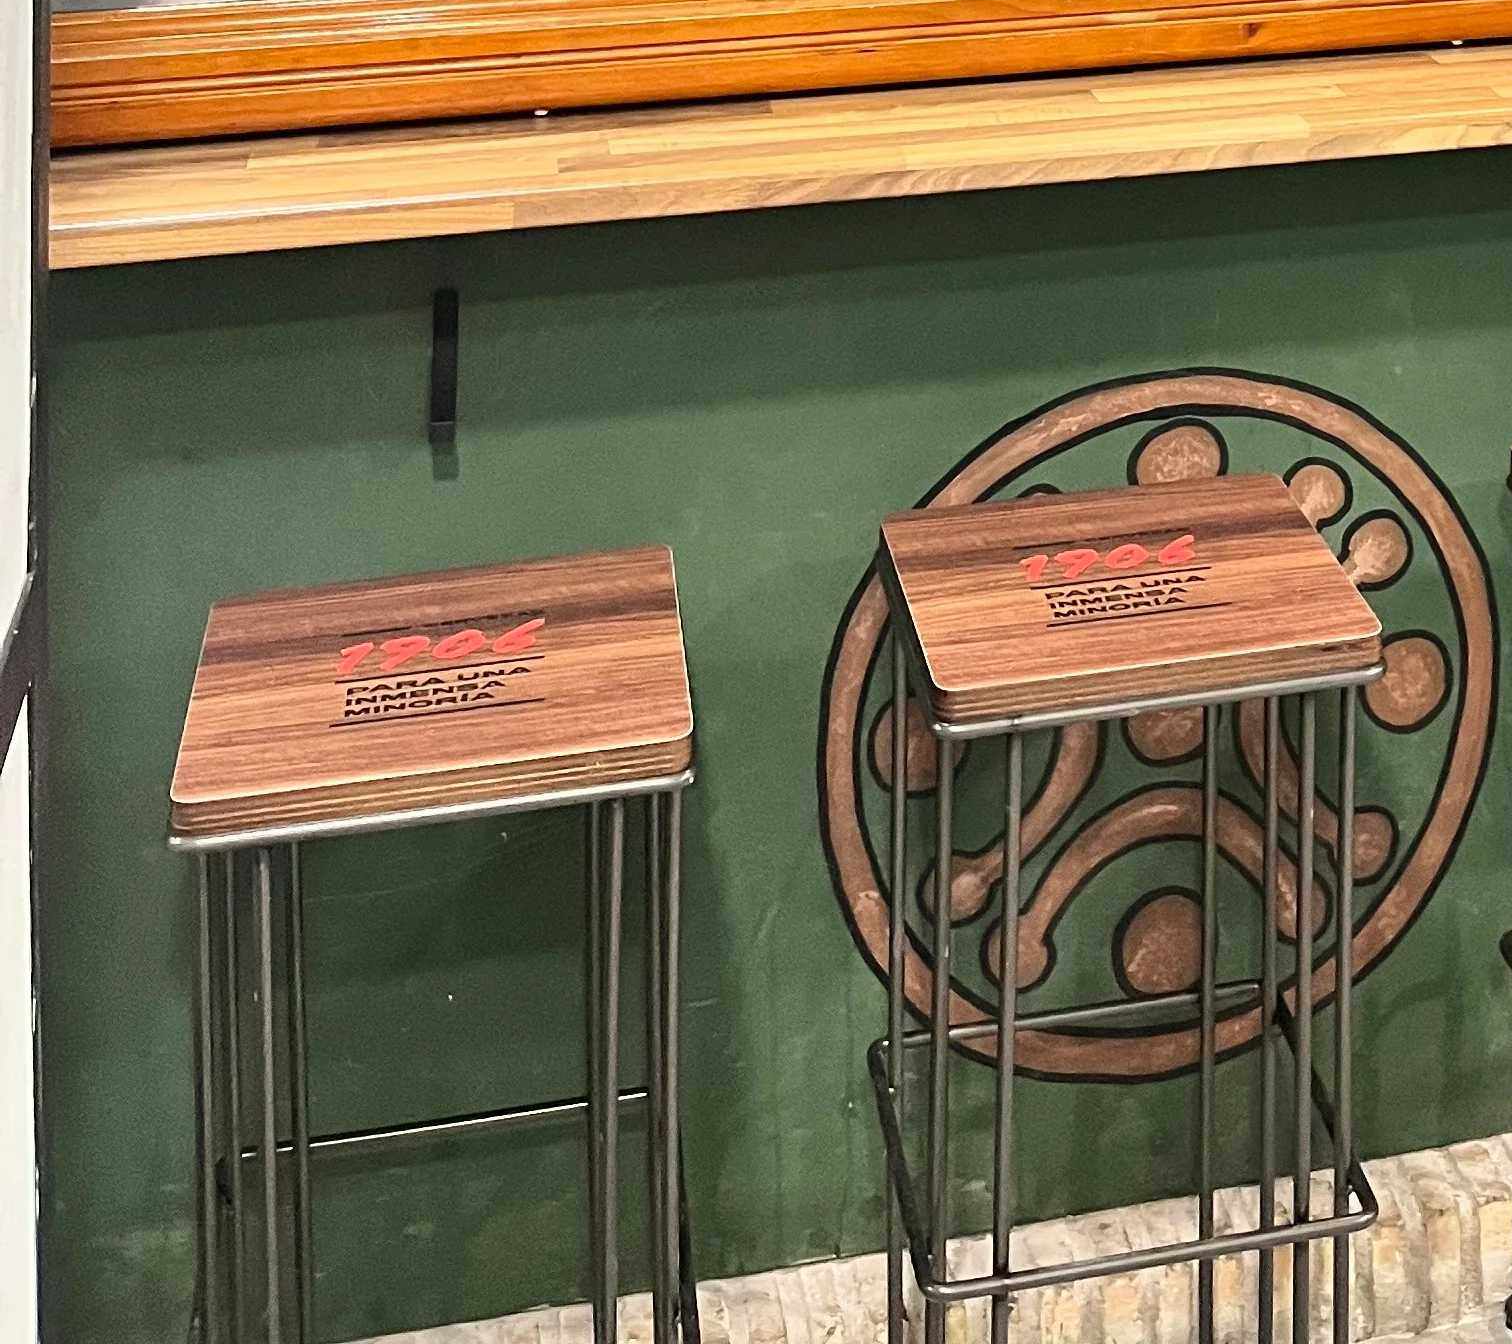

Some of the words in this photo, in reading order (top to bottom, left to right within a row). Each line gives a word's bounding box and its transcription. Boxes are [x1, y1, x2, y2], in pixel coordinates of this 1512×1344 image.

[1019, 534, 1196, 582] 1906
[1045, 584, 1131, 600] PARA
[1140, 574, 1207, 588] UNA
[1049, 586, 1188, 609] INMENSA
[335, 618, 546, 675] 1906
[345, 679, 507, 707] INMENSA
[346, 677, 445, 696] PARA
[456, 666, 533, 681] UNA
